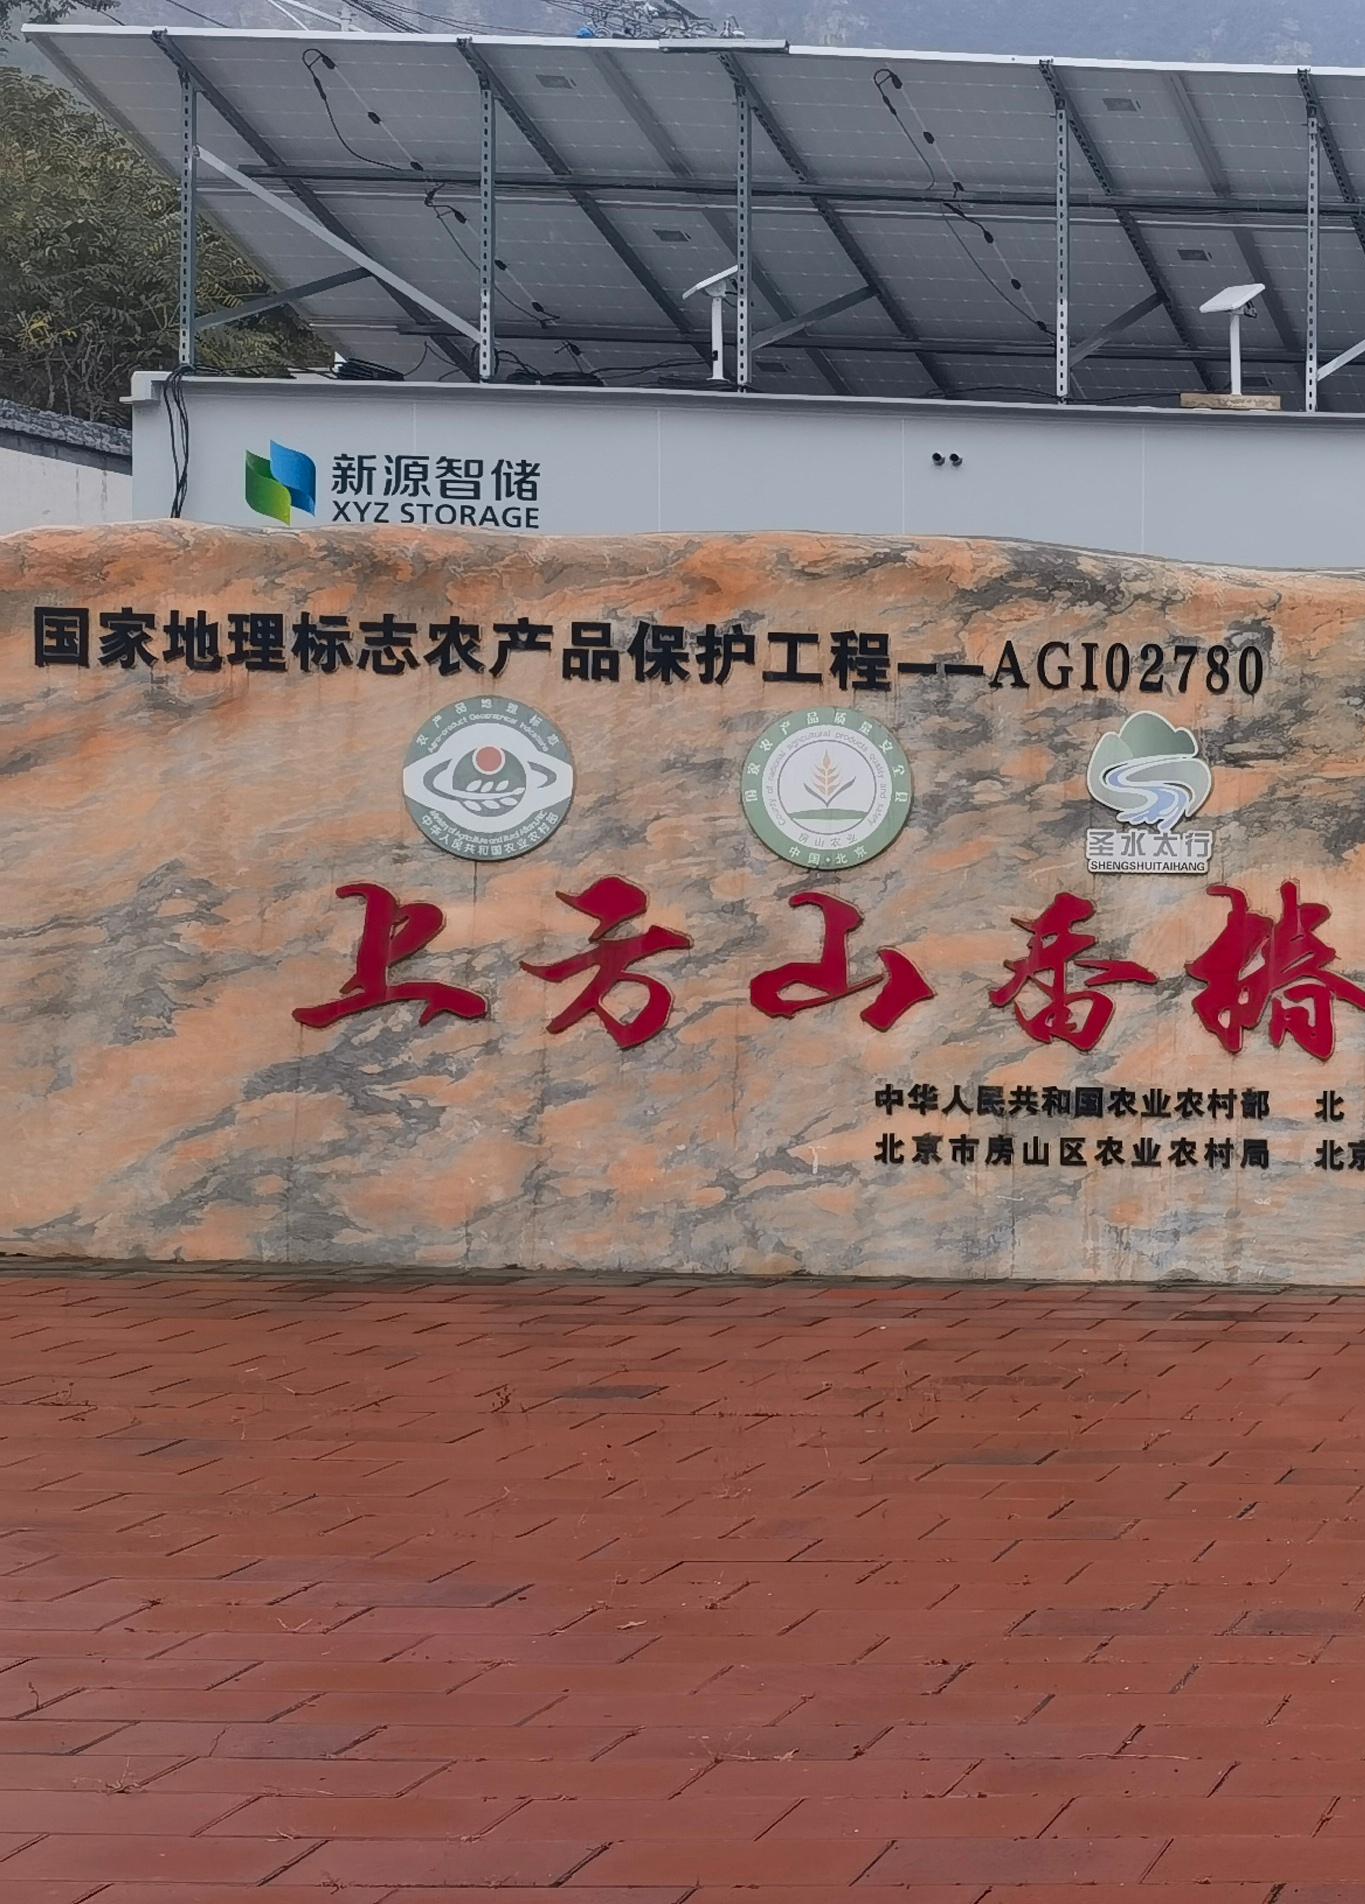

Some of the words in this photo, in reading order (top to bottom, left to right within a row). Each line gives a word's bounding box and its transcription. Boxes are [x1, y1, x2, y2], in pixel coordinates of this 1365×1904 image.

[331, 454, 540, 501] 新源智储
[332, 501, 389, 522] XYZ
[400, 503, 539, 529] STORAGE
[1088, 831, 1210, 857] 圣水太行
[1090, 860, 1206, 872] SHENGSHUITAIHANG
[874, 1084, 1271, 1120] 中华人民共和国农业农村部
[874, 1133, 1271, 1170] 北京市房山区农业农村局
